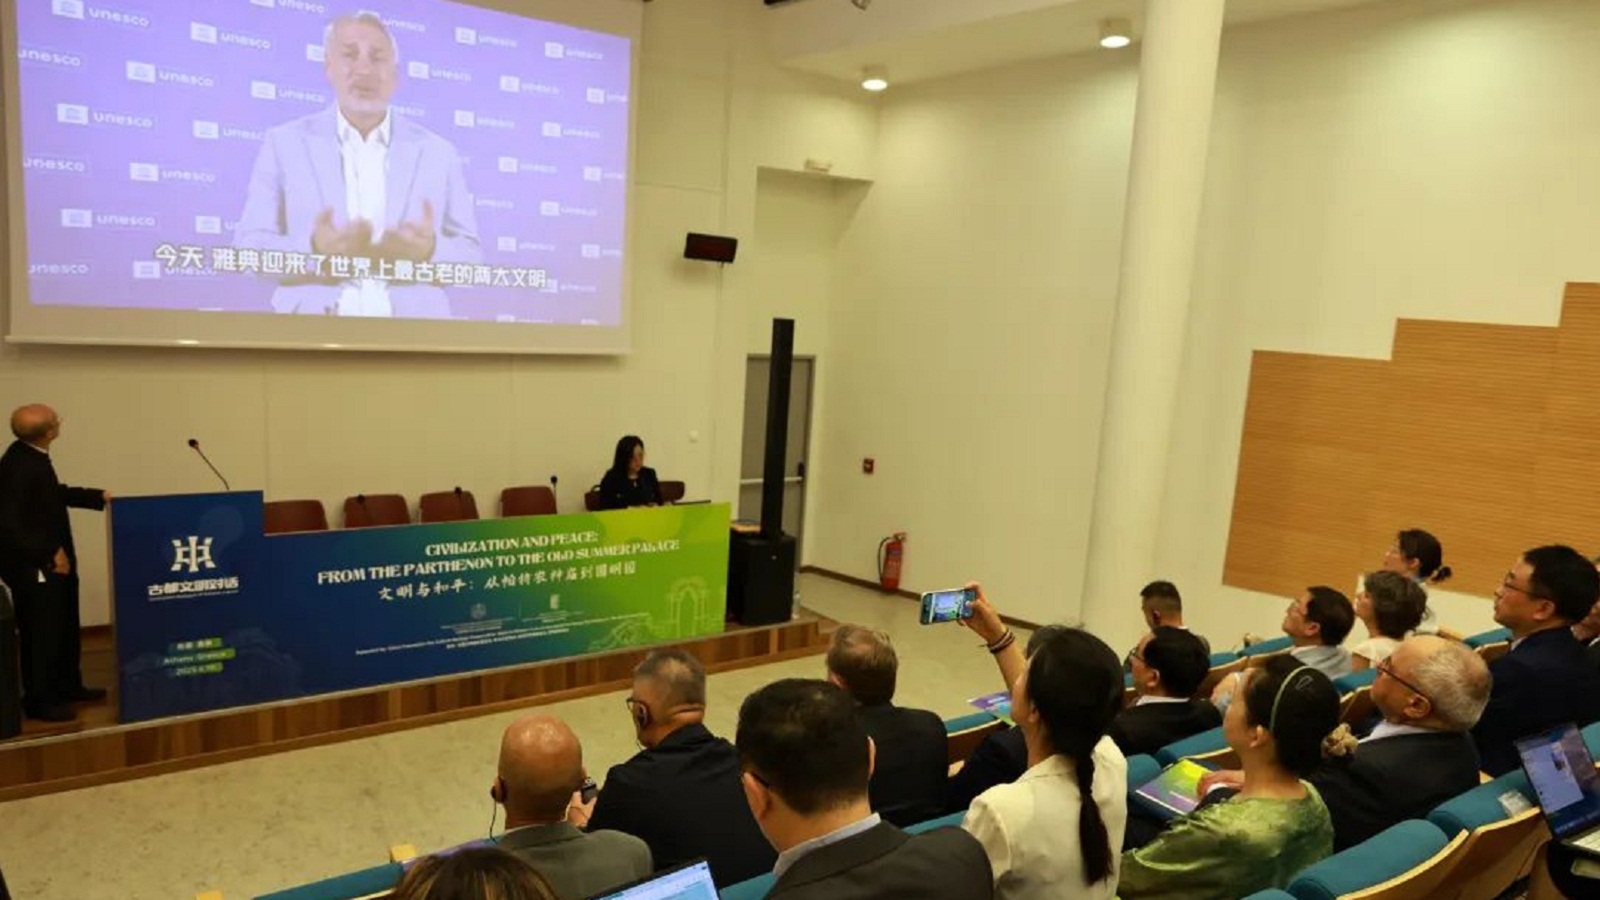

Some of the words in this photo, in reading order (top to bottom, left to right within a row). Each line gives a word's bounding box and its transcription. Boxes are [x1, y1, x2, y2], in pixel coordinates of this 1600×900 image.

[88, 7, 150, 27] unesco
[220, 31, 272, 49] unesco
[158, 70, 214, 87] unesco
[93, 111, 153, 128] unesco
[161, 169, 216, 183] unesco
[96, 214, 156, 228] unesco
[155, 244, 203, 268] 今天
[425, 538, 519, 556] CIVILIZATION
[521, 535, 549, 548] AND
[550, 530, 598, 546] PEACE:
[317, 567, 366, 585] FROM
[368, 564, 401, 580] THE
[403, 557, 494, 577] PARTHENON
[497, 554, 516, 567] TO
[517, 551, 545, 565] THE
[547, 548, 574, 562] OLD
[576, 543, 631, 560] SUMMER
[632, 539, 680, 554] PALACE
